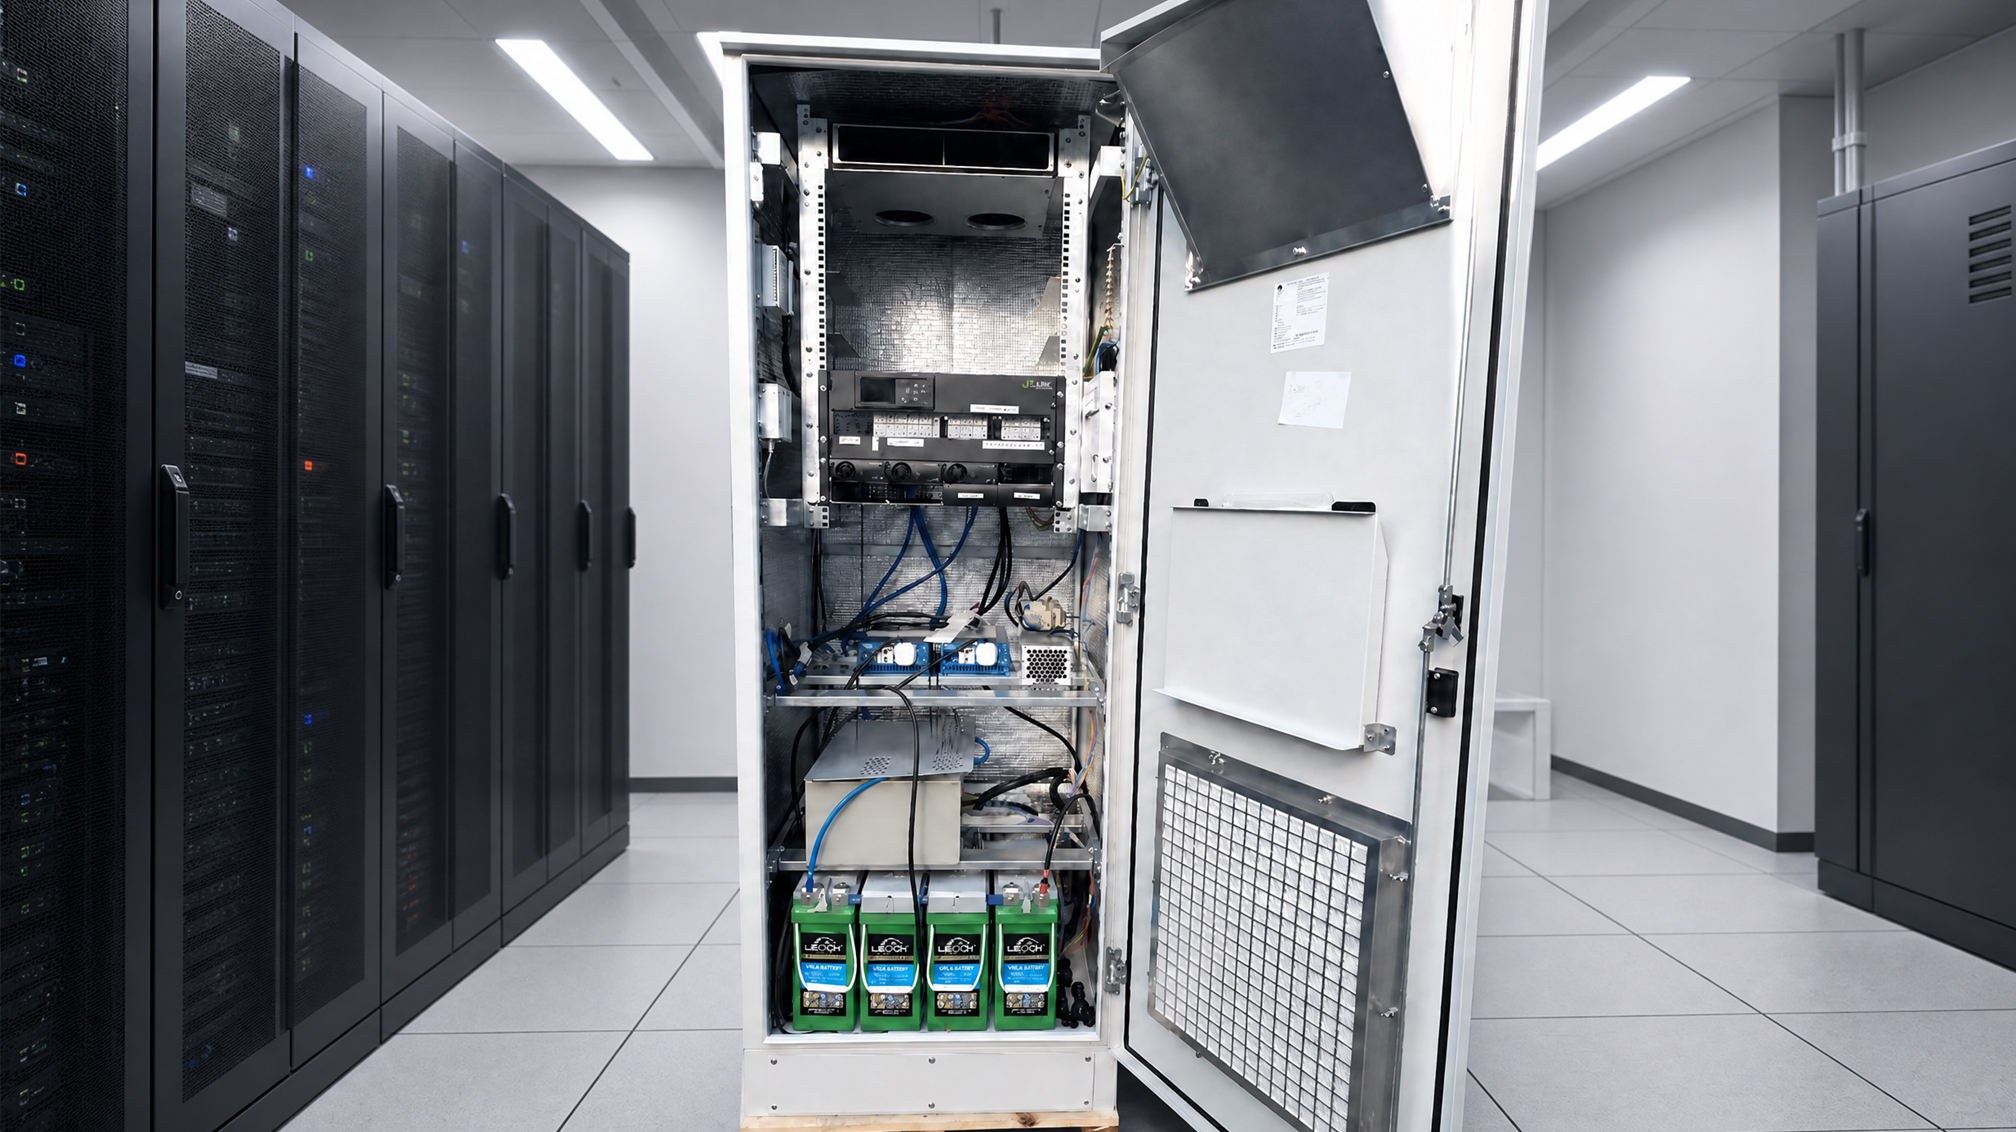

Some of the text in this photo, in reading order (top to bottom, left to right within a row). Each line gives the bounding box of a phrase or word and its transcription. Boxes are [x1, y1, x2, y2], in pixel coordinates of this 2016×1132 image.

[804, 944, 841, 952] LEOCH
[871, 945, 908, 953] LEOCH
[937, 945, 974, 953] LEOCH
